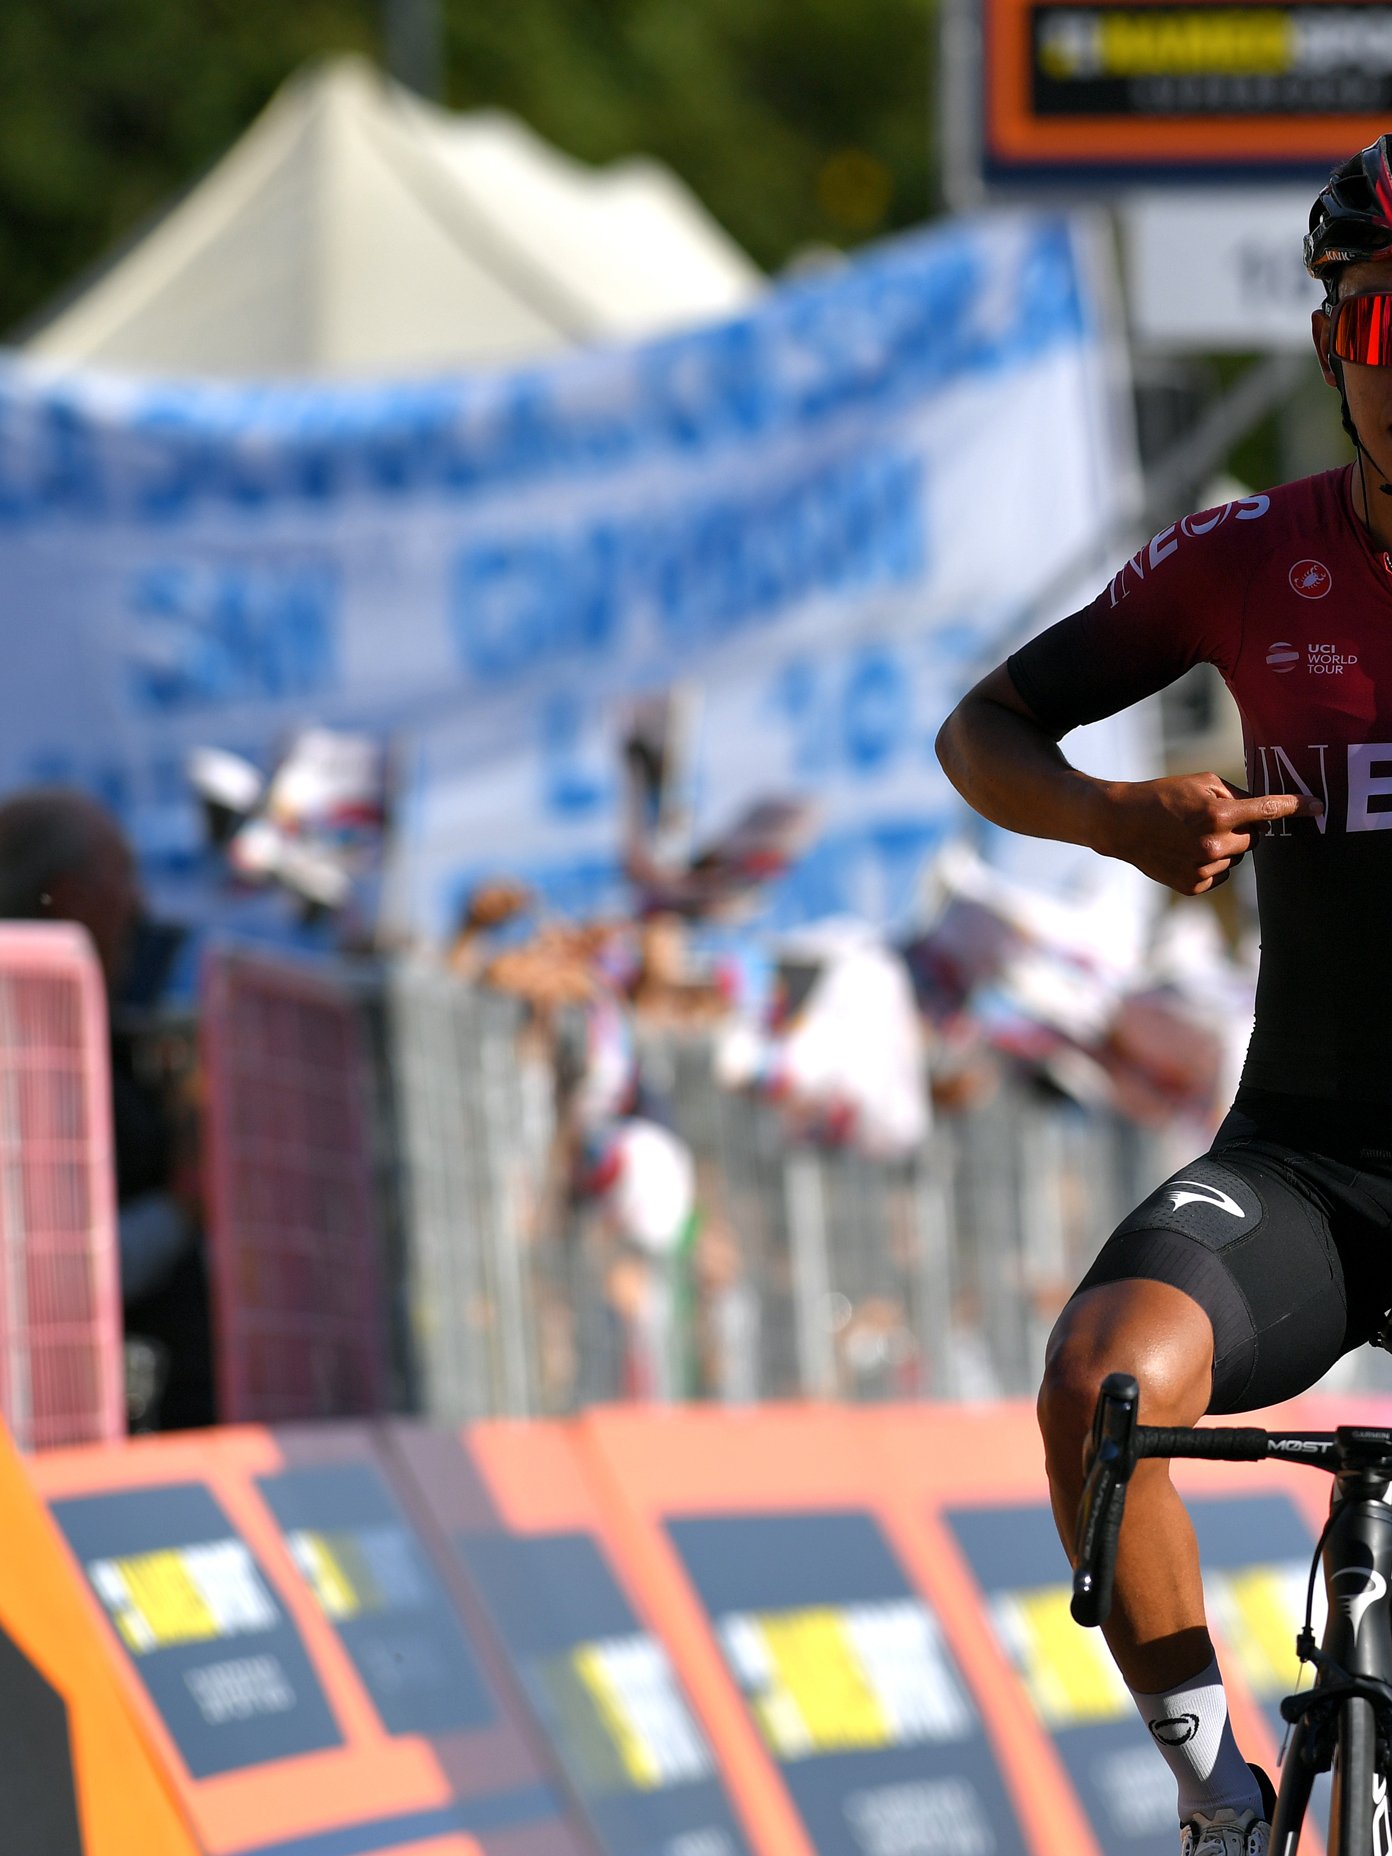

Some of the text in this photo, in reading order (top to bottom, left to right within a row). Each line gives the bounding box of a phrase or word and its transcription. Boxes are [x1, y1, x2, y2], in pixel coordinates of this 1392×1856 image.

[1307, 643, 1336, 654] UCI
[1307, 653, 1358, 665] WORLD
[1307, 664, 1344, 675] TOUR
